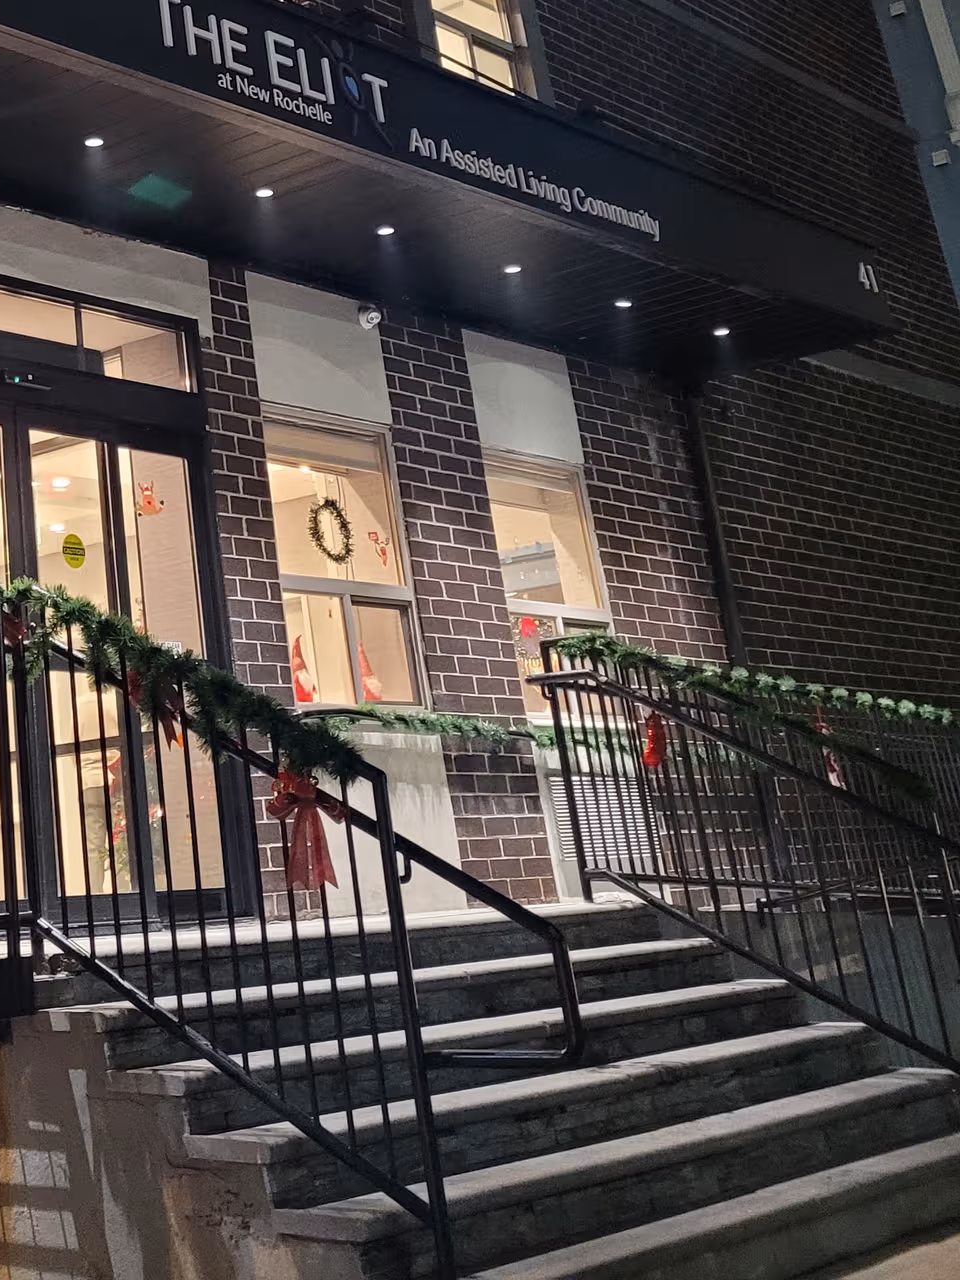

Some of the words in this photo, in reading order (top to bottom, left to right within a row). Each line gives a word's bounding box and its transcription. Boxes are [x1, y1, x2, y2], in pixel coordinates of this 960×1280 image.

[217, 72, 233, 90] at
[237, 75, 270, 104] New
[274, 89, 333, 125] Rochelle
[409, 127, 437, 160] An
[440, 138, 518, 189] Assisted
[517, 166, 572, 213] Living
[572, 187, 660, 242] Community
[859, 262, 879, 292] 41
